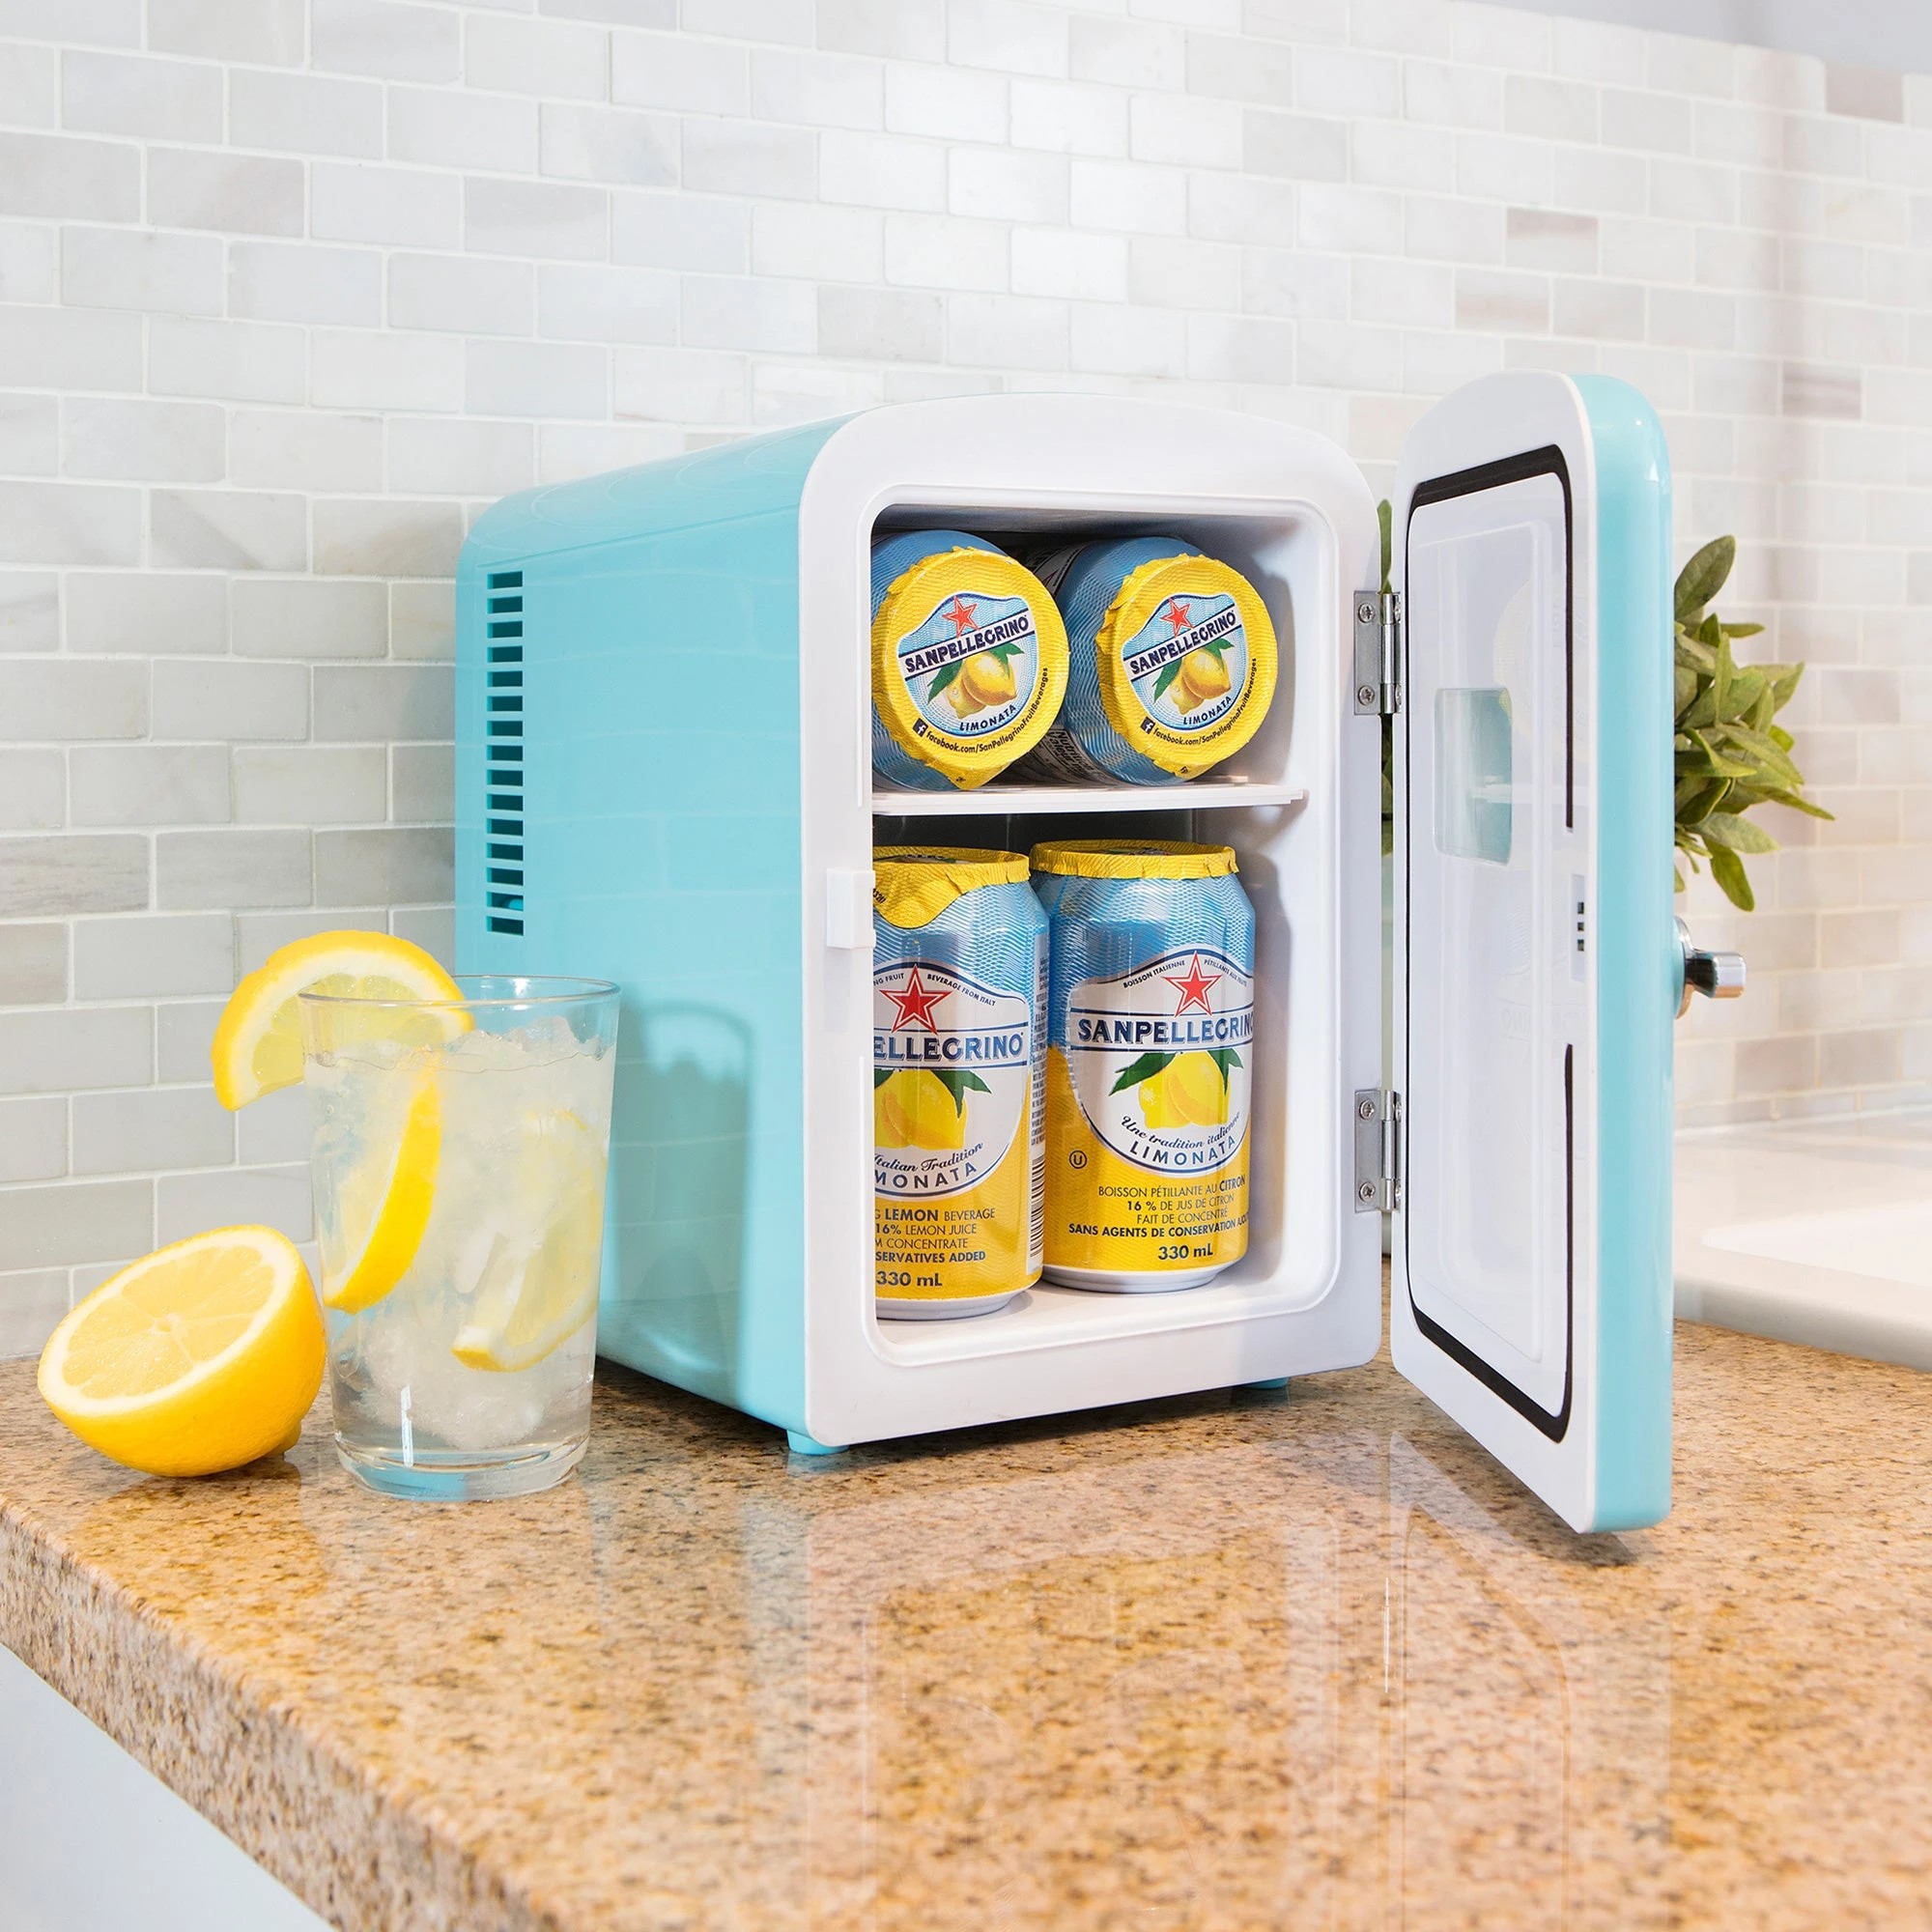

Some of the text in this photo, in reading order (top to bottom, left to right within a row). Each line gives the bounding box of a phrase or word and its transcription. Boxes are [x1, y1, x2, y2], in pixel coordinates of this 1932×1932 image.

[904, 616, 1029, 673] SANPELLEGRINO
[1130, 611, 1236, 675] SANPELLEGRINO
[959, 704, 1016, 731] LIMONATA
[1182, 696, 1232, 725] LIMONATA
[1122, 971, 1152, 988] BOISSON
[1152, 960, 1185, 976] ITALIENNE
[885, 973, 905, 982] FRUIT
[927, 974, 961, 991] BEVERAGE
[961, 987, 979, 1001] FROM
[1121, 1112, 1240, 1150] Une tradition italienne
[921, 1142, 984, 1172] Tradition
[1129, 1135, 1236, 1166] LIMONATA
[1098, 1174, 1246, 1198] BOISSON PÉTILLANTE AU CITRON
[1127, 1194, 1235, 1211] 16 % DE JUS DE CITRON
[885, 1208, 939, 1222] LEMON
[944, 1208, 996, 1221] BEVERAGE
[1137, 1213, 1159, 1225] FAIT
[1161, 1213, 1175, 1224] DE
[1178, 1207, 1228, 1224] CONCENTRÉ
[875, 1223, 978, 1236] 16% LEMON JUICE
[1068, 1219, 1236, 1237] SANS AGENTS DE CONSERVATION
[886, 1237, 969, 1250] CONCENTRATE
[1158, 1243, 1214, 1261] 330 mL
[875, 1251, 986, 1264] SERVATIVES ADDED
[876, 1270, 943, 1287] 330 mL
